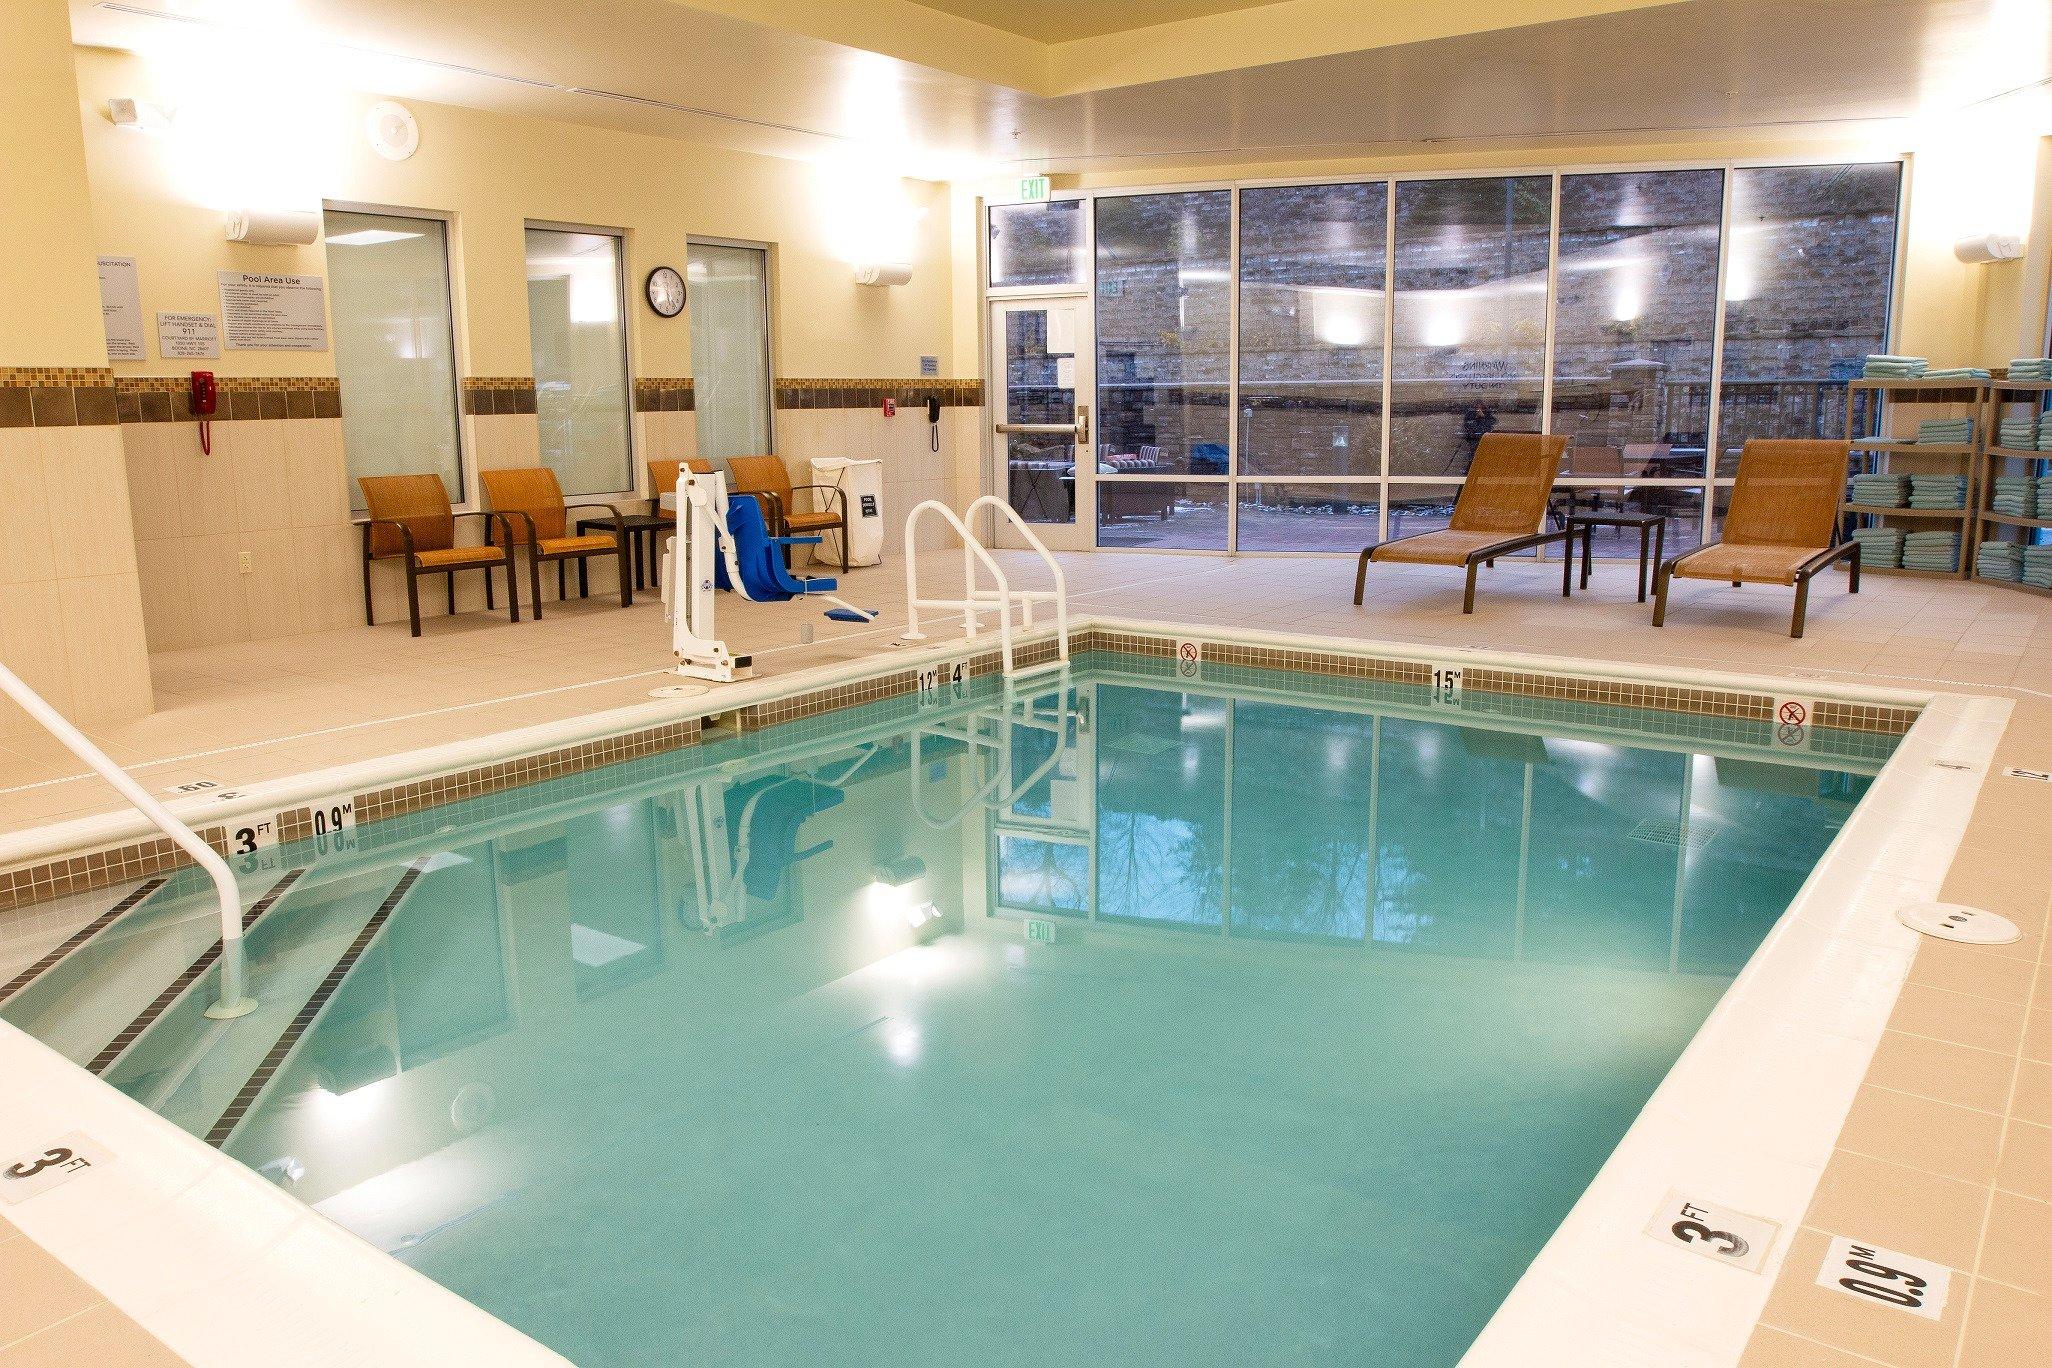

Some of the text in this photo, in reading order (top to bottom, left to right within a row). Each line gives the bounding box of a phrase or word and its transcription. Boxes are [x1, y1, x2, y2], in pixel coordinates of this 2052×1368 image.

[1021, 178, 1045, 200] EXIT
[242, 274, 301, 285] Pool Area Use
[953, 664, 962, 682] 4
[1454, 671, 1460, 679] M
[342, 803, 352, 814] M
[235, 822, 271, 855] 3 FT
[3, 1147, 91, 1180] 3 FT
[1671, 1202, 1750, 1258] 3 FT
[1838, 1244, 1928, 1308] 0.9 M
